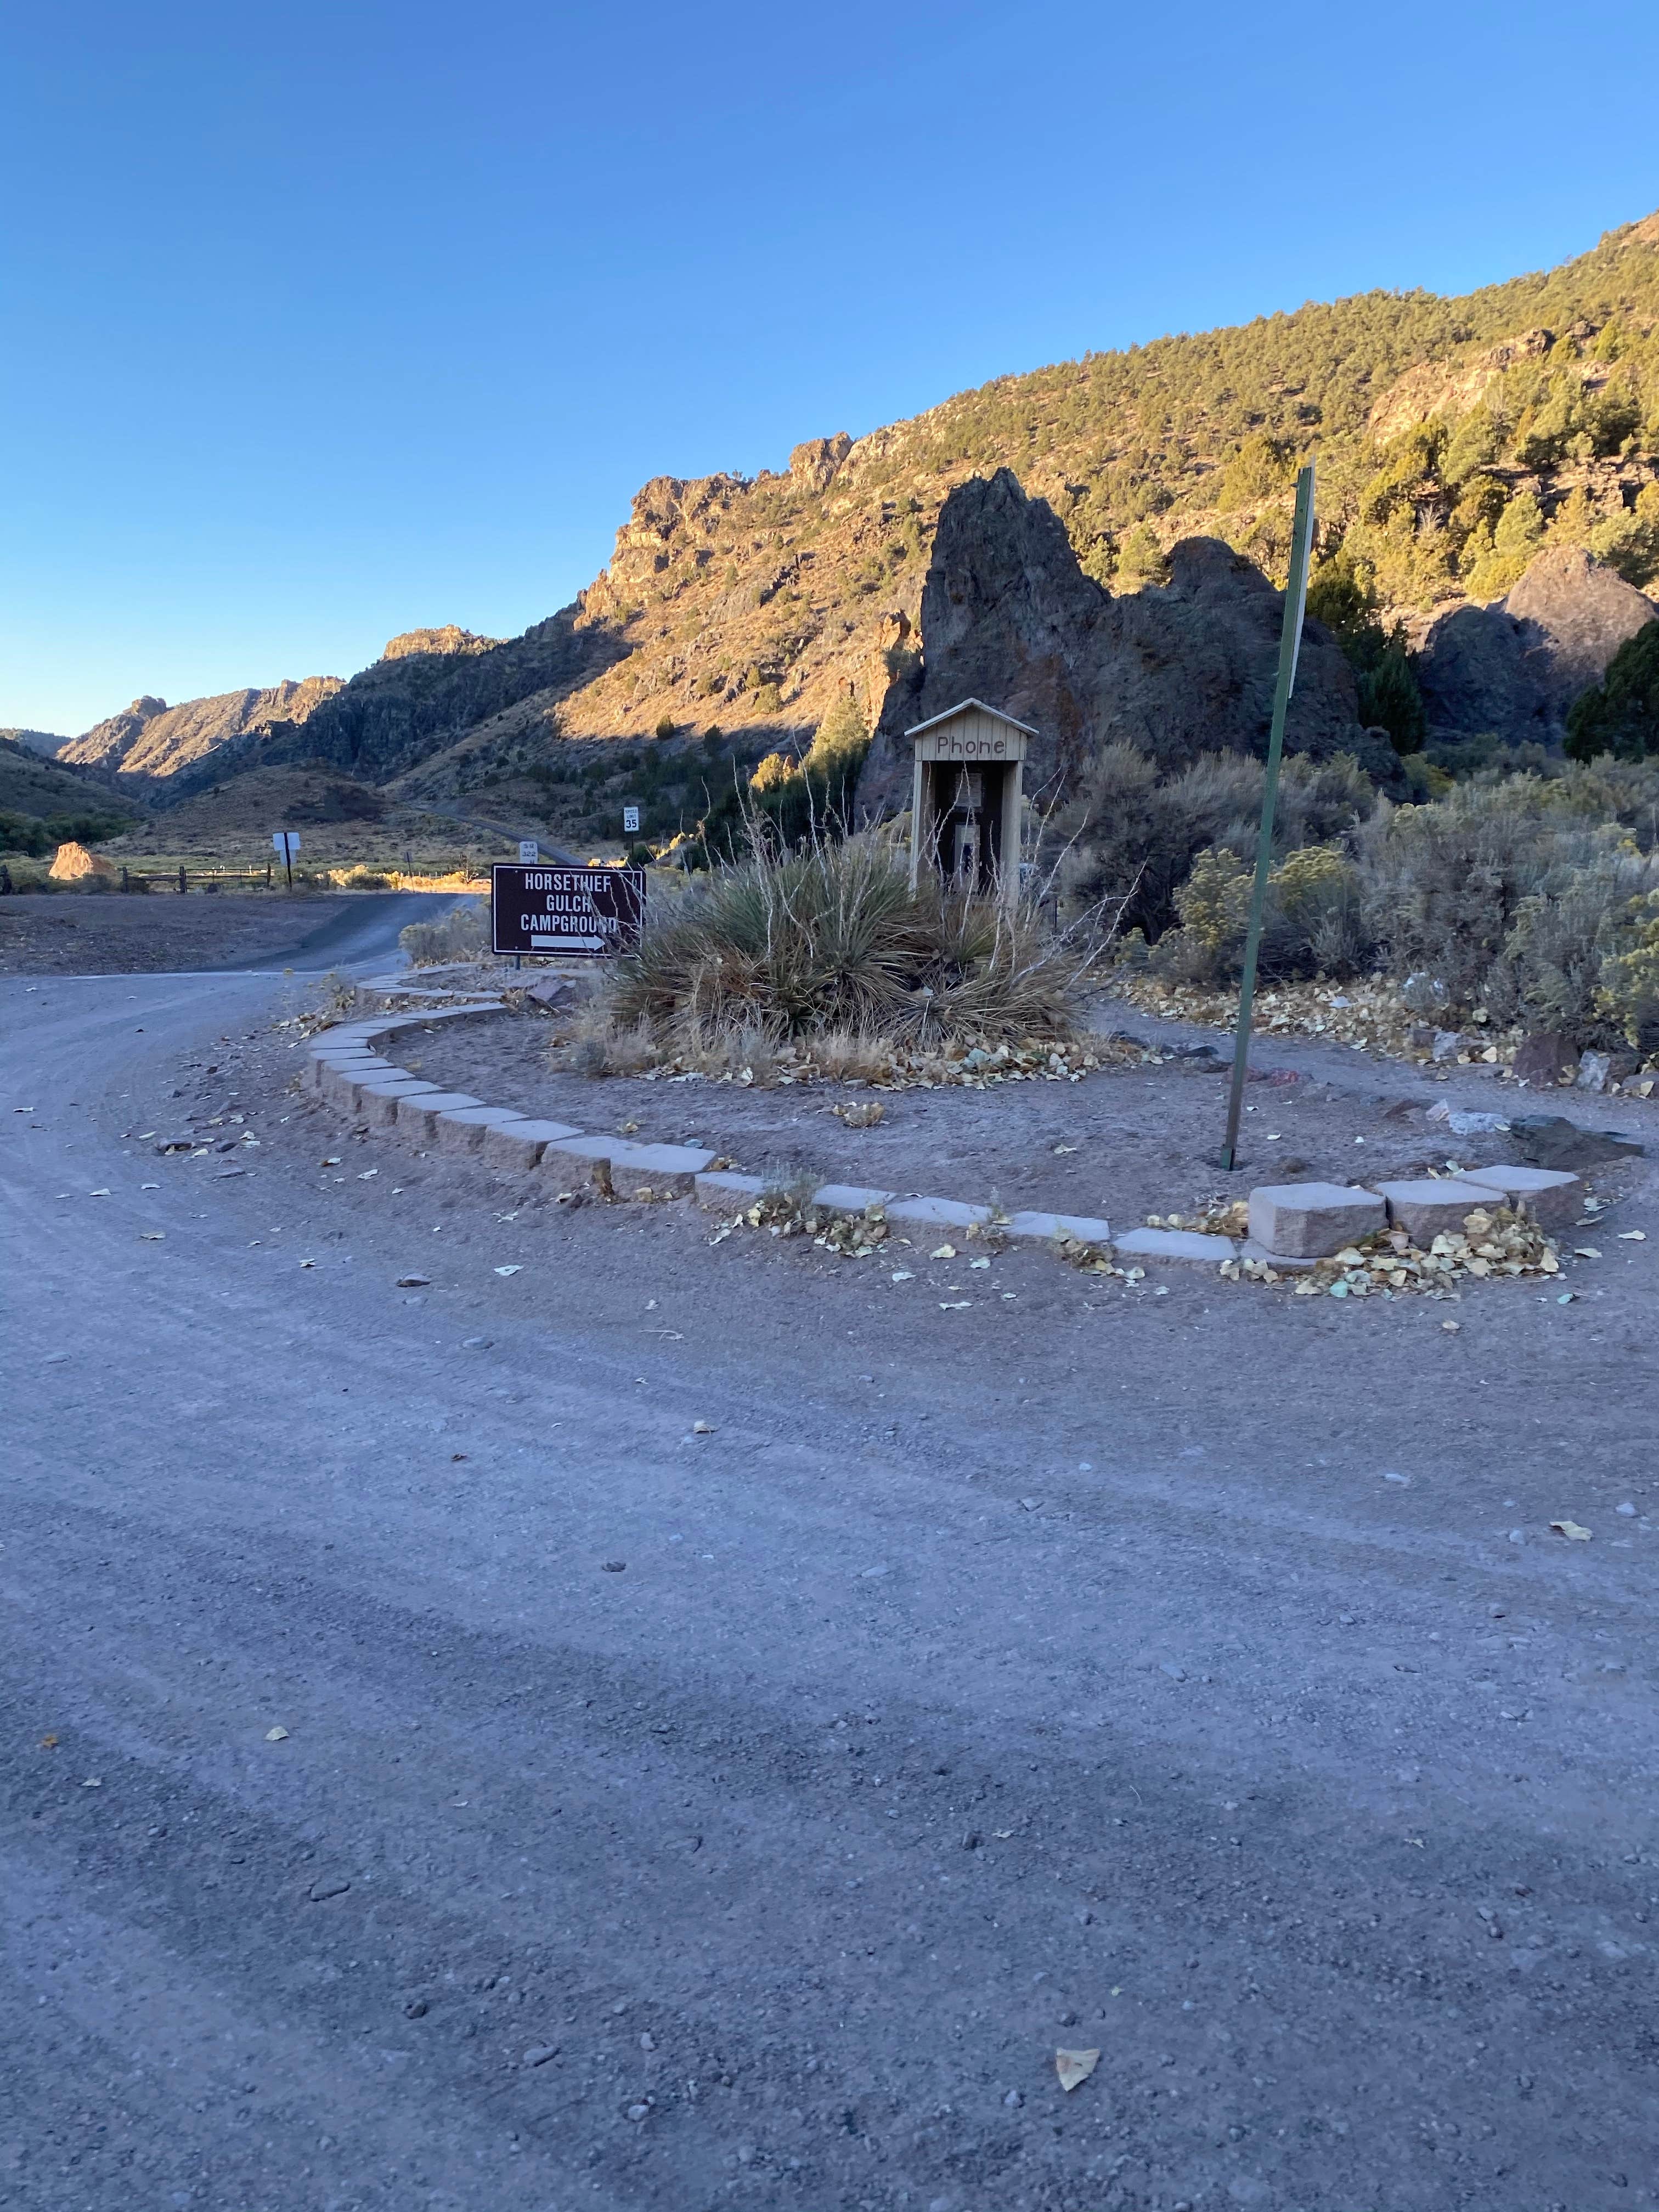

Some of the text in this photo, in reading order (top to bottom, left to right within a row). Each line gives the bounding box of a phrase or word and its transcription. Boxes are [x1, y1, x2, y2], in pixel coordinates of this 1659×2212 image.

[938, 736, 1005, 754] Phone
[626, 819, 636, 828] 35
[525, 873, 611, 892] HORSETHIEF
[546, 895, 591, 912] GULCH
